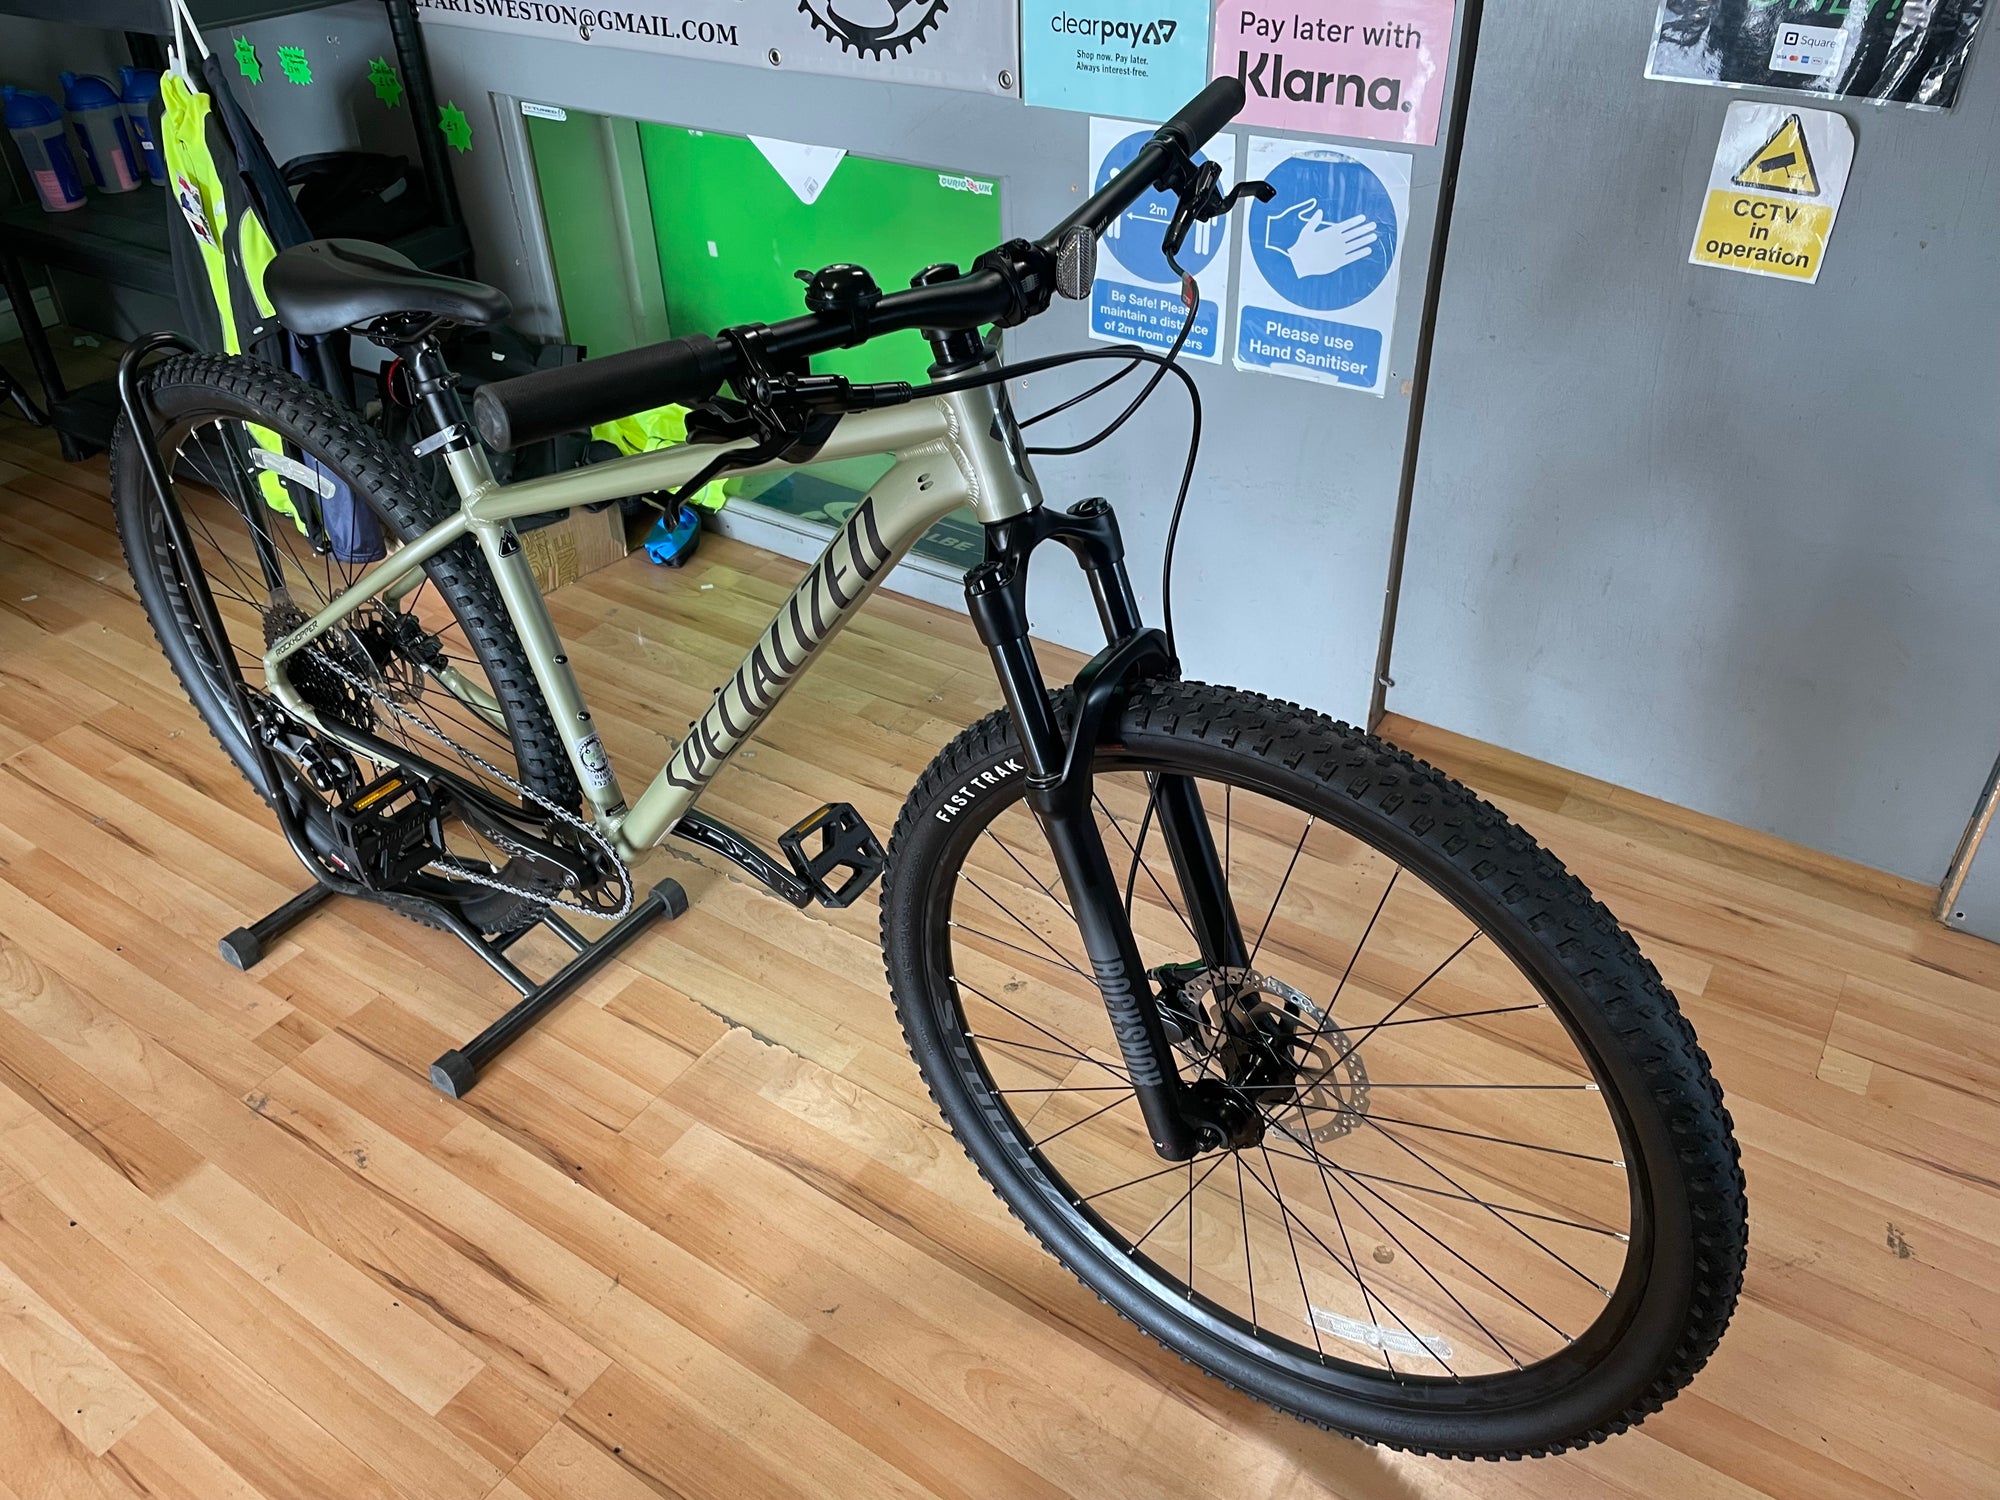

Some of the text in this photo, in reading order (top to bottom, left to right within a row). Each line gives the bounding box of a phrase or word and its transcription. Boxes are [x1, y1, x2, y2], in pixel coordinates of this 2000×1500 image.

[1051, 11, 1143, 48] clearpay
[1240, 11, 1422, 50] Pay later with
[1800, 35, 1837, 49] Square
[1076, 49, 1149, 66] Shop now. Pay later.
[1076, 61, 1149, 78] Always interest-free.
[1238, 50, 1412, 113] Klarna.
[1149, 202, 1168, 217] 2m
[1733, 199, 1799, 224] CCTV
[1749, 222, 1769, 241] in
[1706, 239, 1810, 269] operation
[1100, 304, 1147, 323] maintain
[1149, 315, 1157, 326] a
[1111, 289, 1198, 318] Be Safe! Pleas
[1104, 320, 1116, 332] of
[1117, 322, 1135, 335] 2m
[1137, 326, 1163, 342] from
[1266, 320, 1354, 351] Please use
[1249, 338, 1368, 375] Hand Sanitiser
[666, 497, 892, 791] SPECIALIZED
[935, 757, 1024, 823] FAST TRAK
[1091, 959, 1164, 1087] ROCKSHOX
